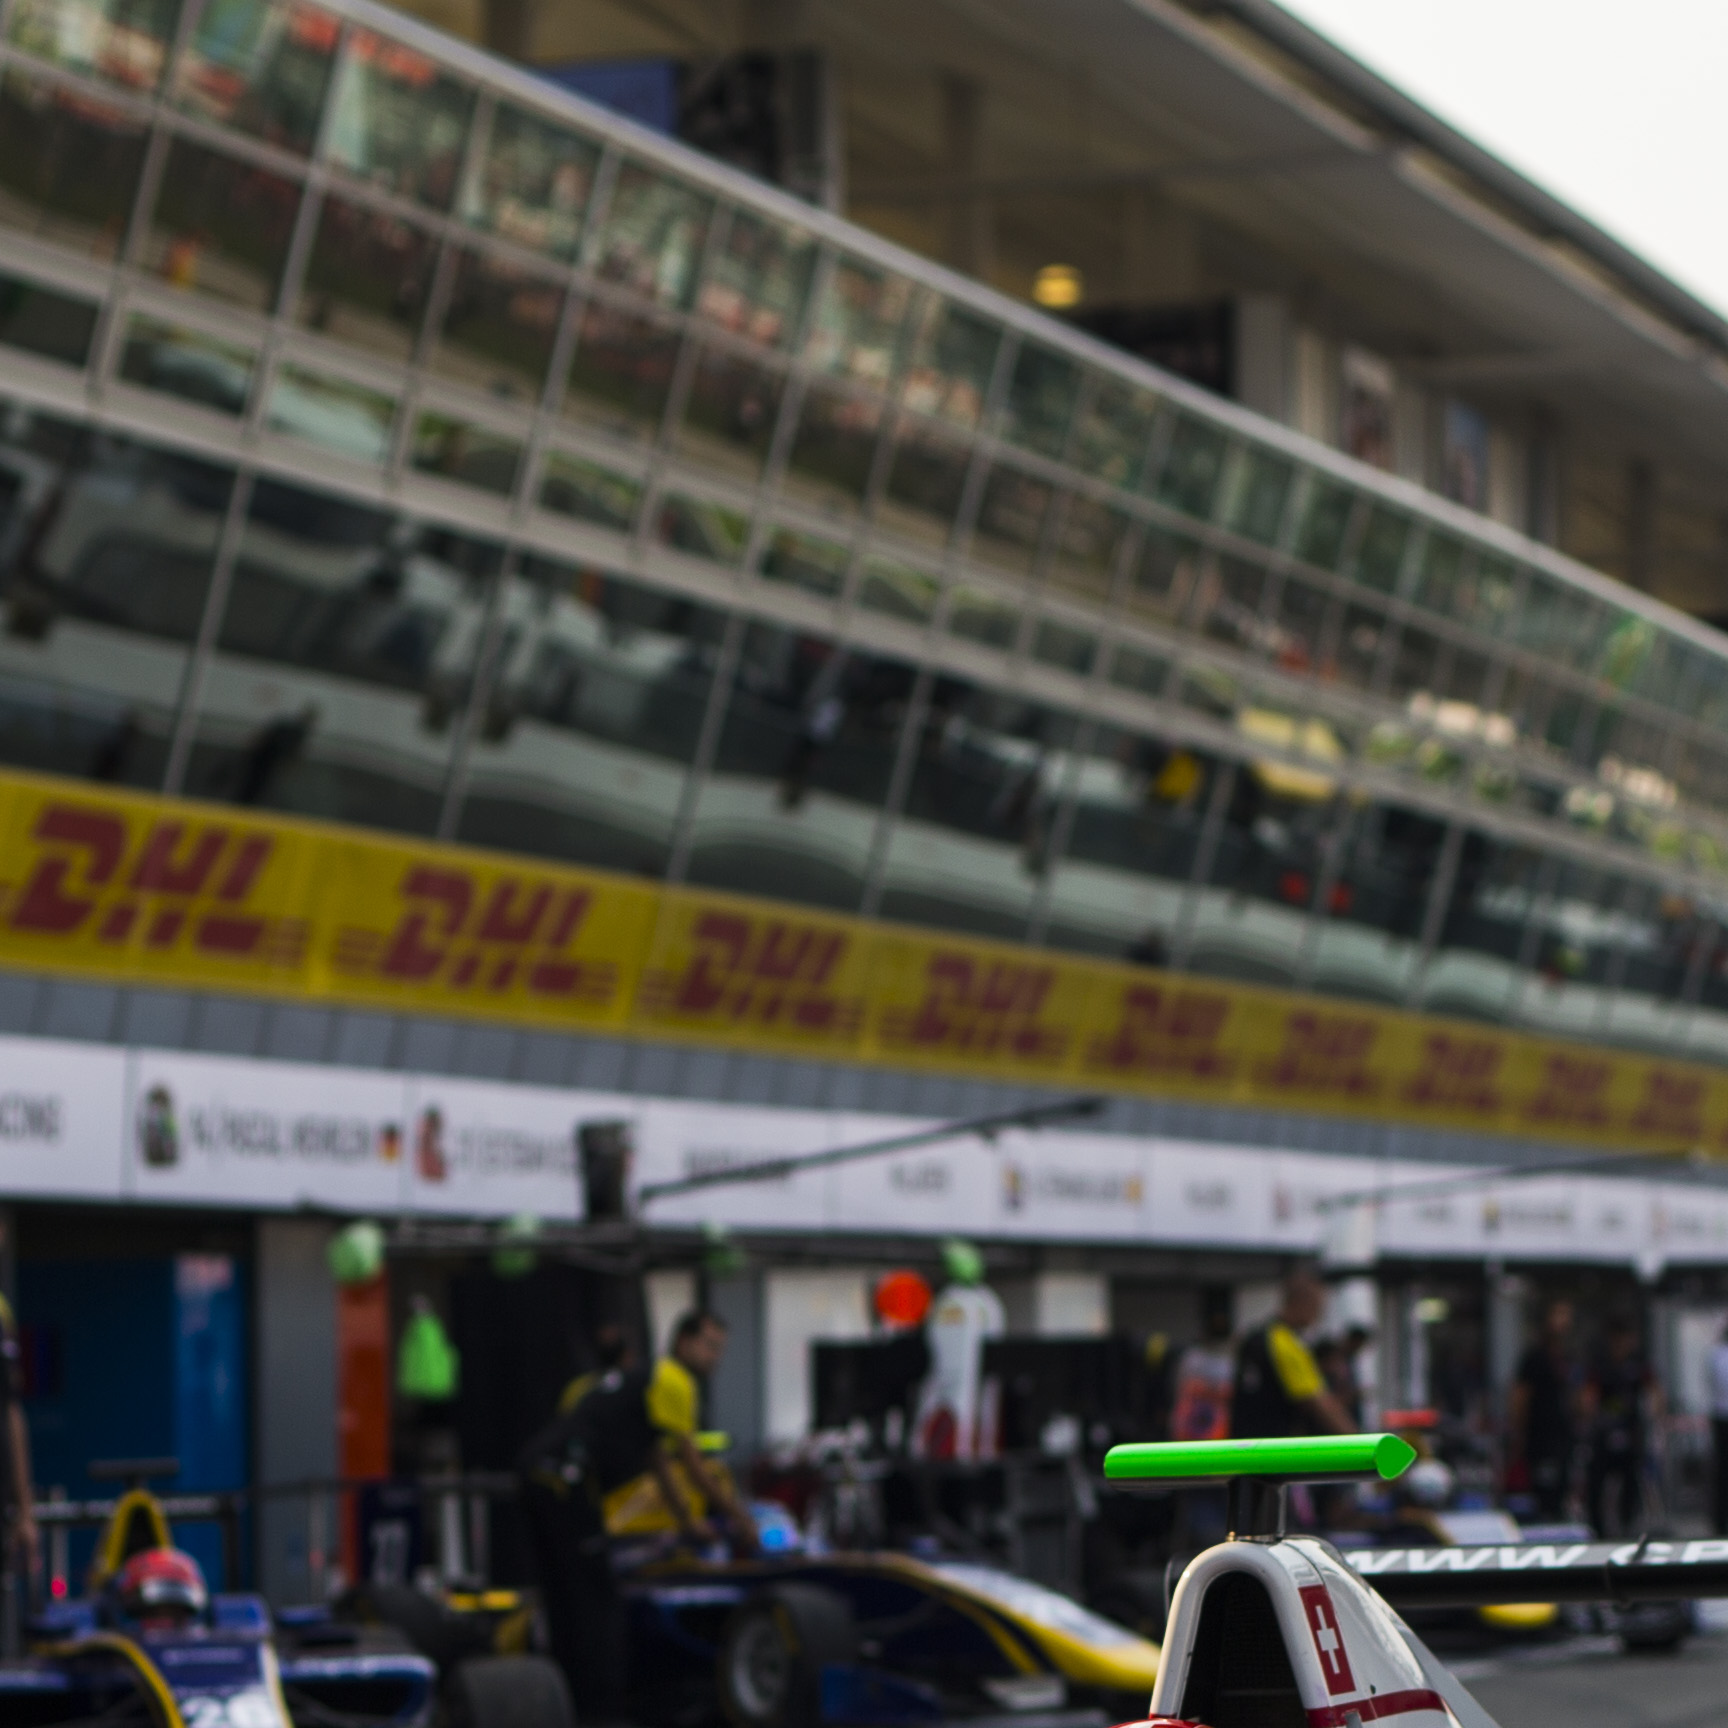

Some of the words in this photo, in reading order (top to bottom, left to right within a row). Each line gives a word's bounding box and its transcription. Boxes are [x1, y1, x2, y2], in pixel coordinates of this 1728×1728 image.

[8, 804, 274, 958] DHL
[378, 864, 592, 996] DHL
[672, 910, 852, 1046] DHL
[906, 952, 1058, 1062] DHL
